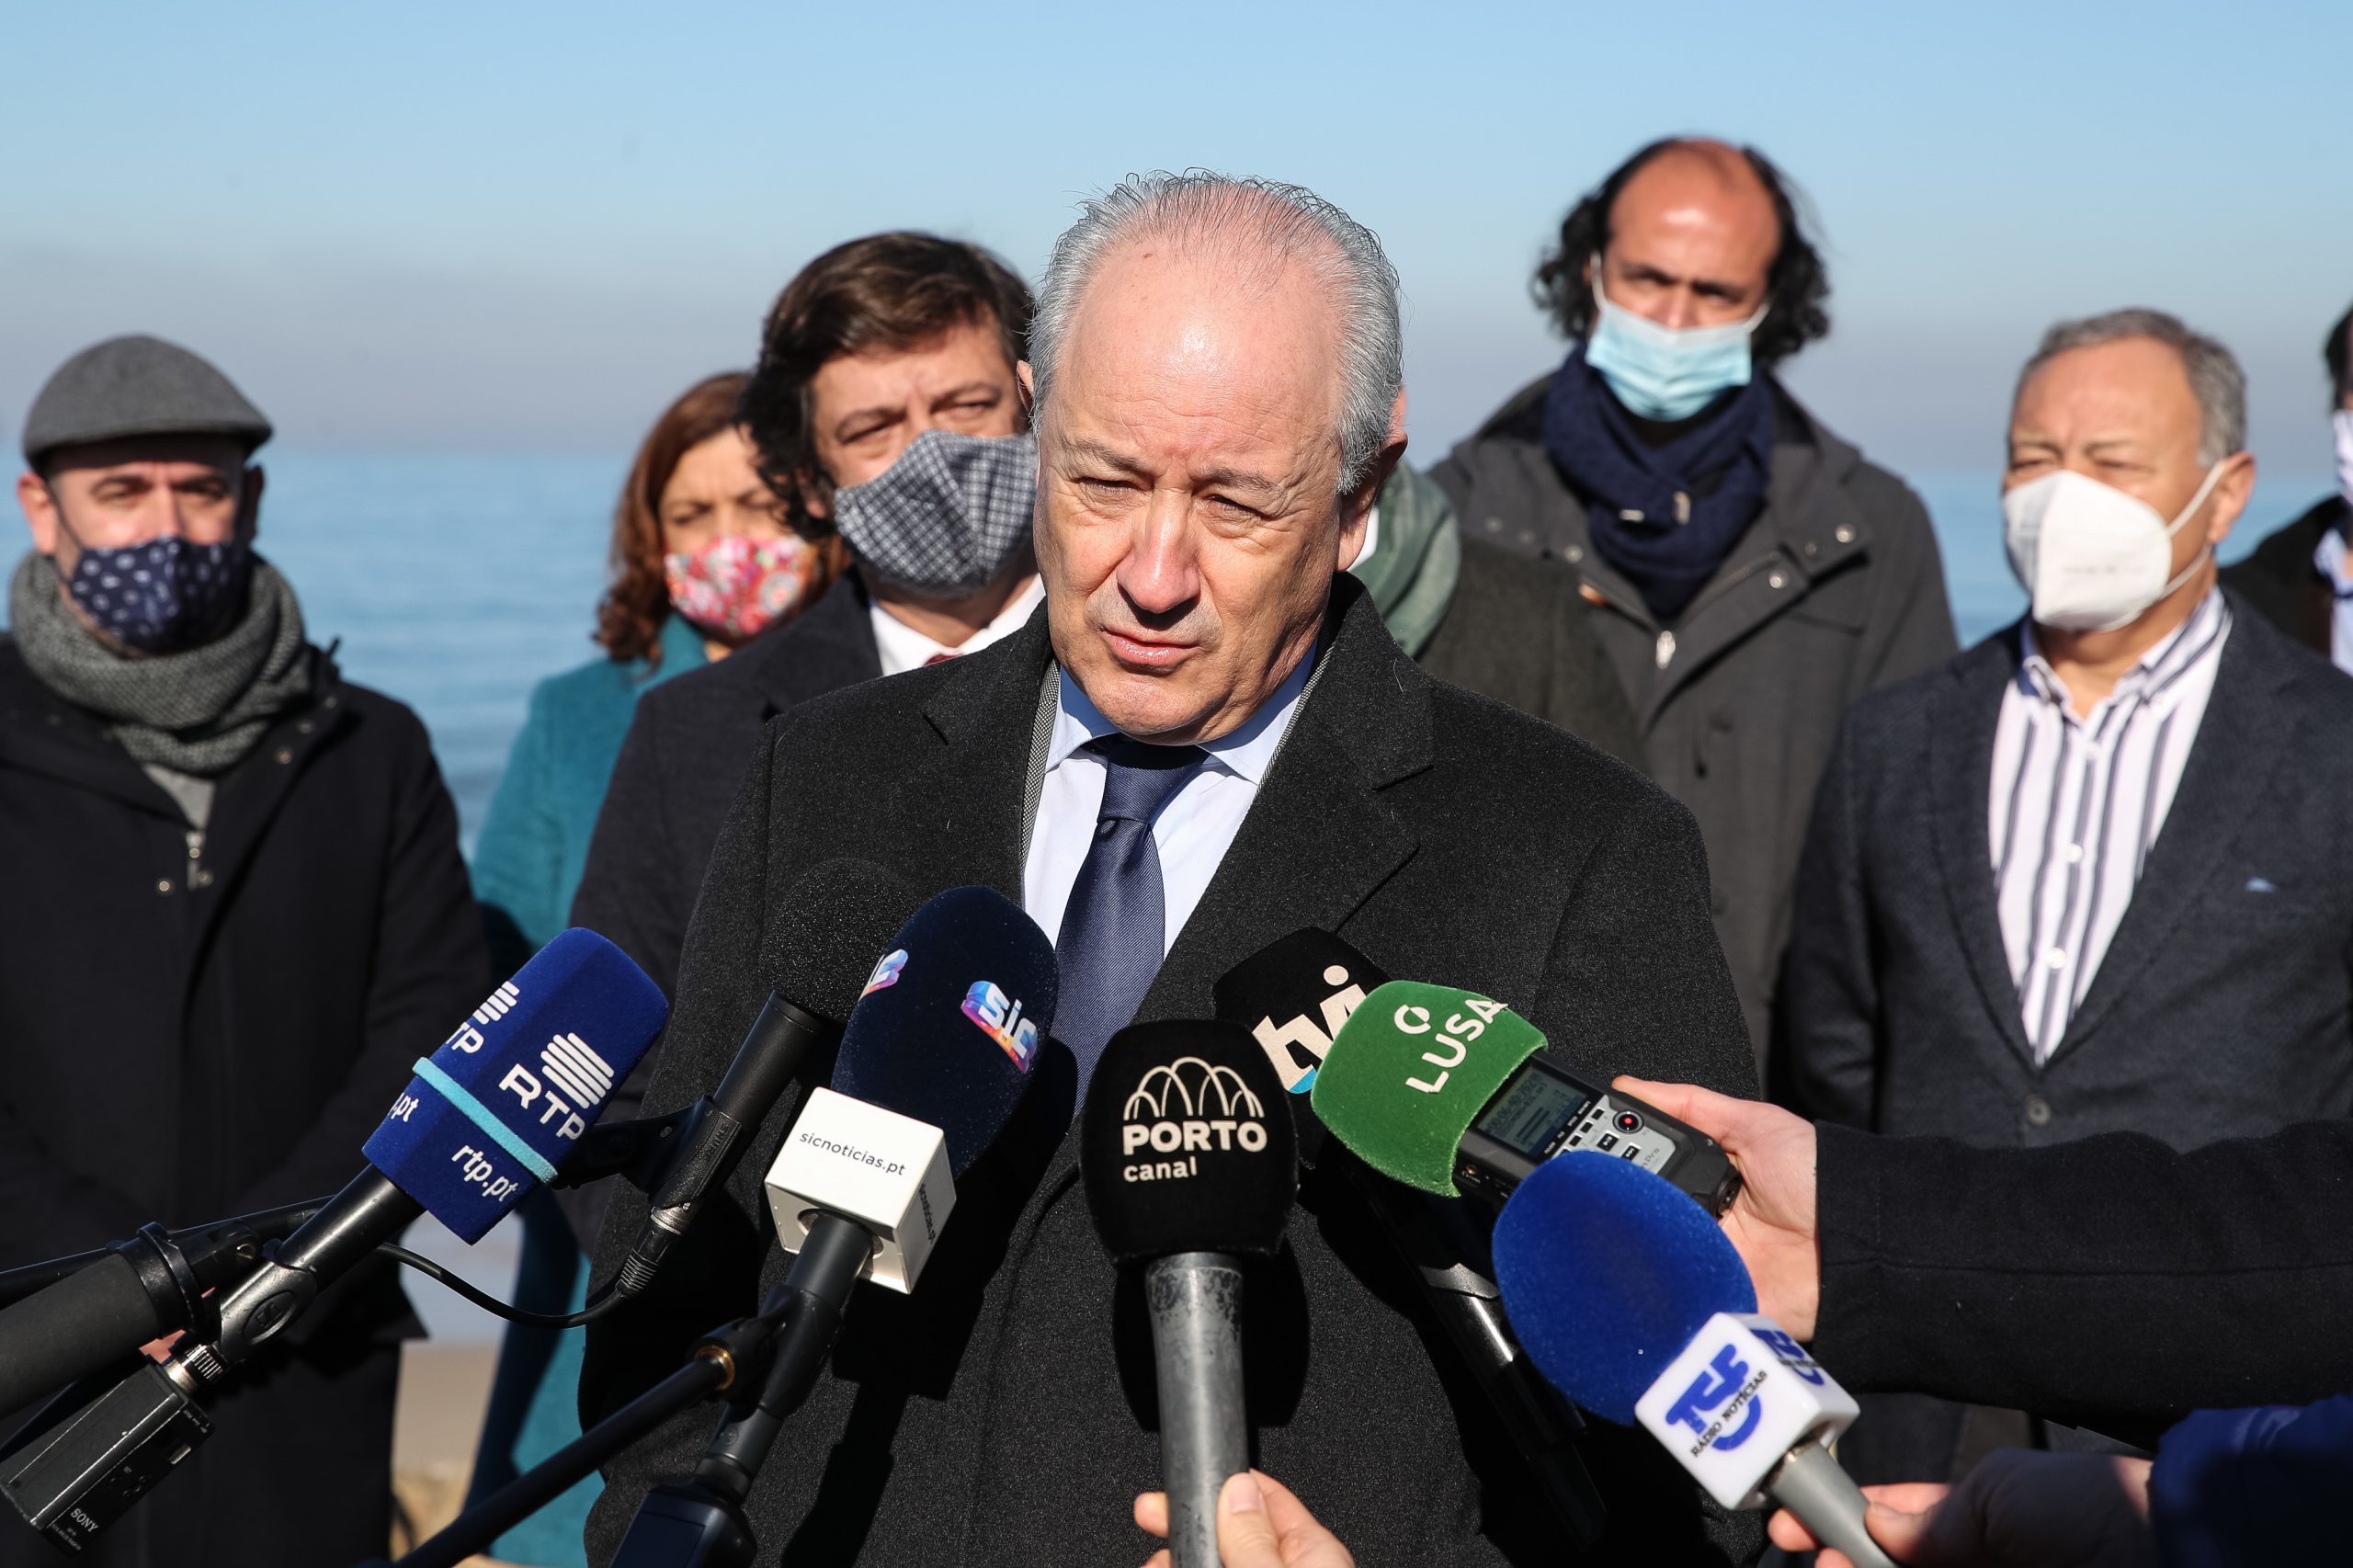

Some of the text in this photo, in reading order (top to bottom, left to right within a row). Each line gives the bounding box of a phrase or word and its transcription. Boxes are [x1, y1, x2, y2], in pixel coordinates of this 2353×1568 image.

[445, 1022, 484, 1053] TP
[1405, 998, 1508, 1093] LUSA
[498, 1063, 585, 1140] RTP
[799, 1131, 906, 1176] sicnoticias.pt
[1122, 1120, 1268, 1155] PORTO
[451, 1145, 519, 1202] rtp.pt
[1123, 1156, 1198, 1183] canal
[1665, 1344, 1749, 1435] TSF
[71, 1508, 99, 1533] SONY
